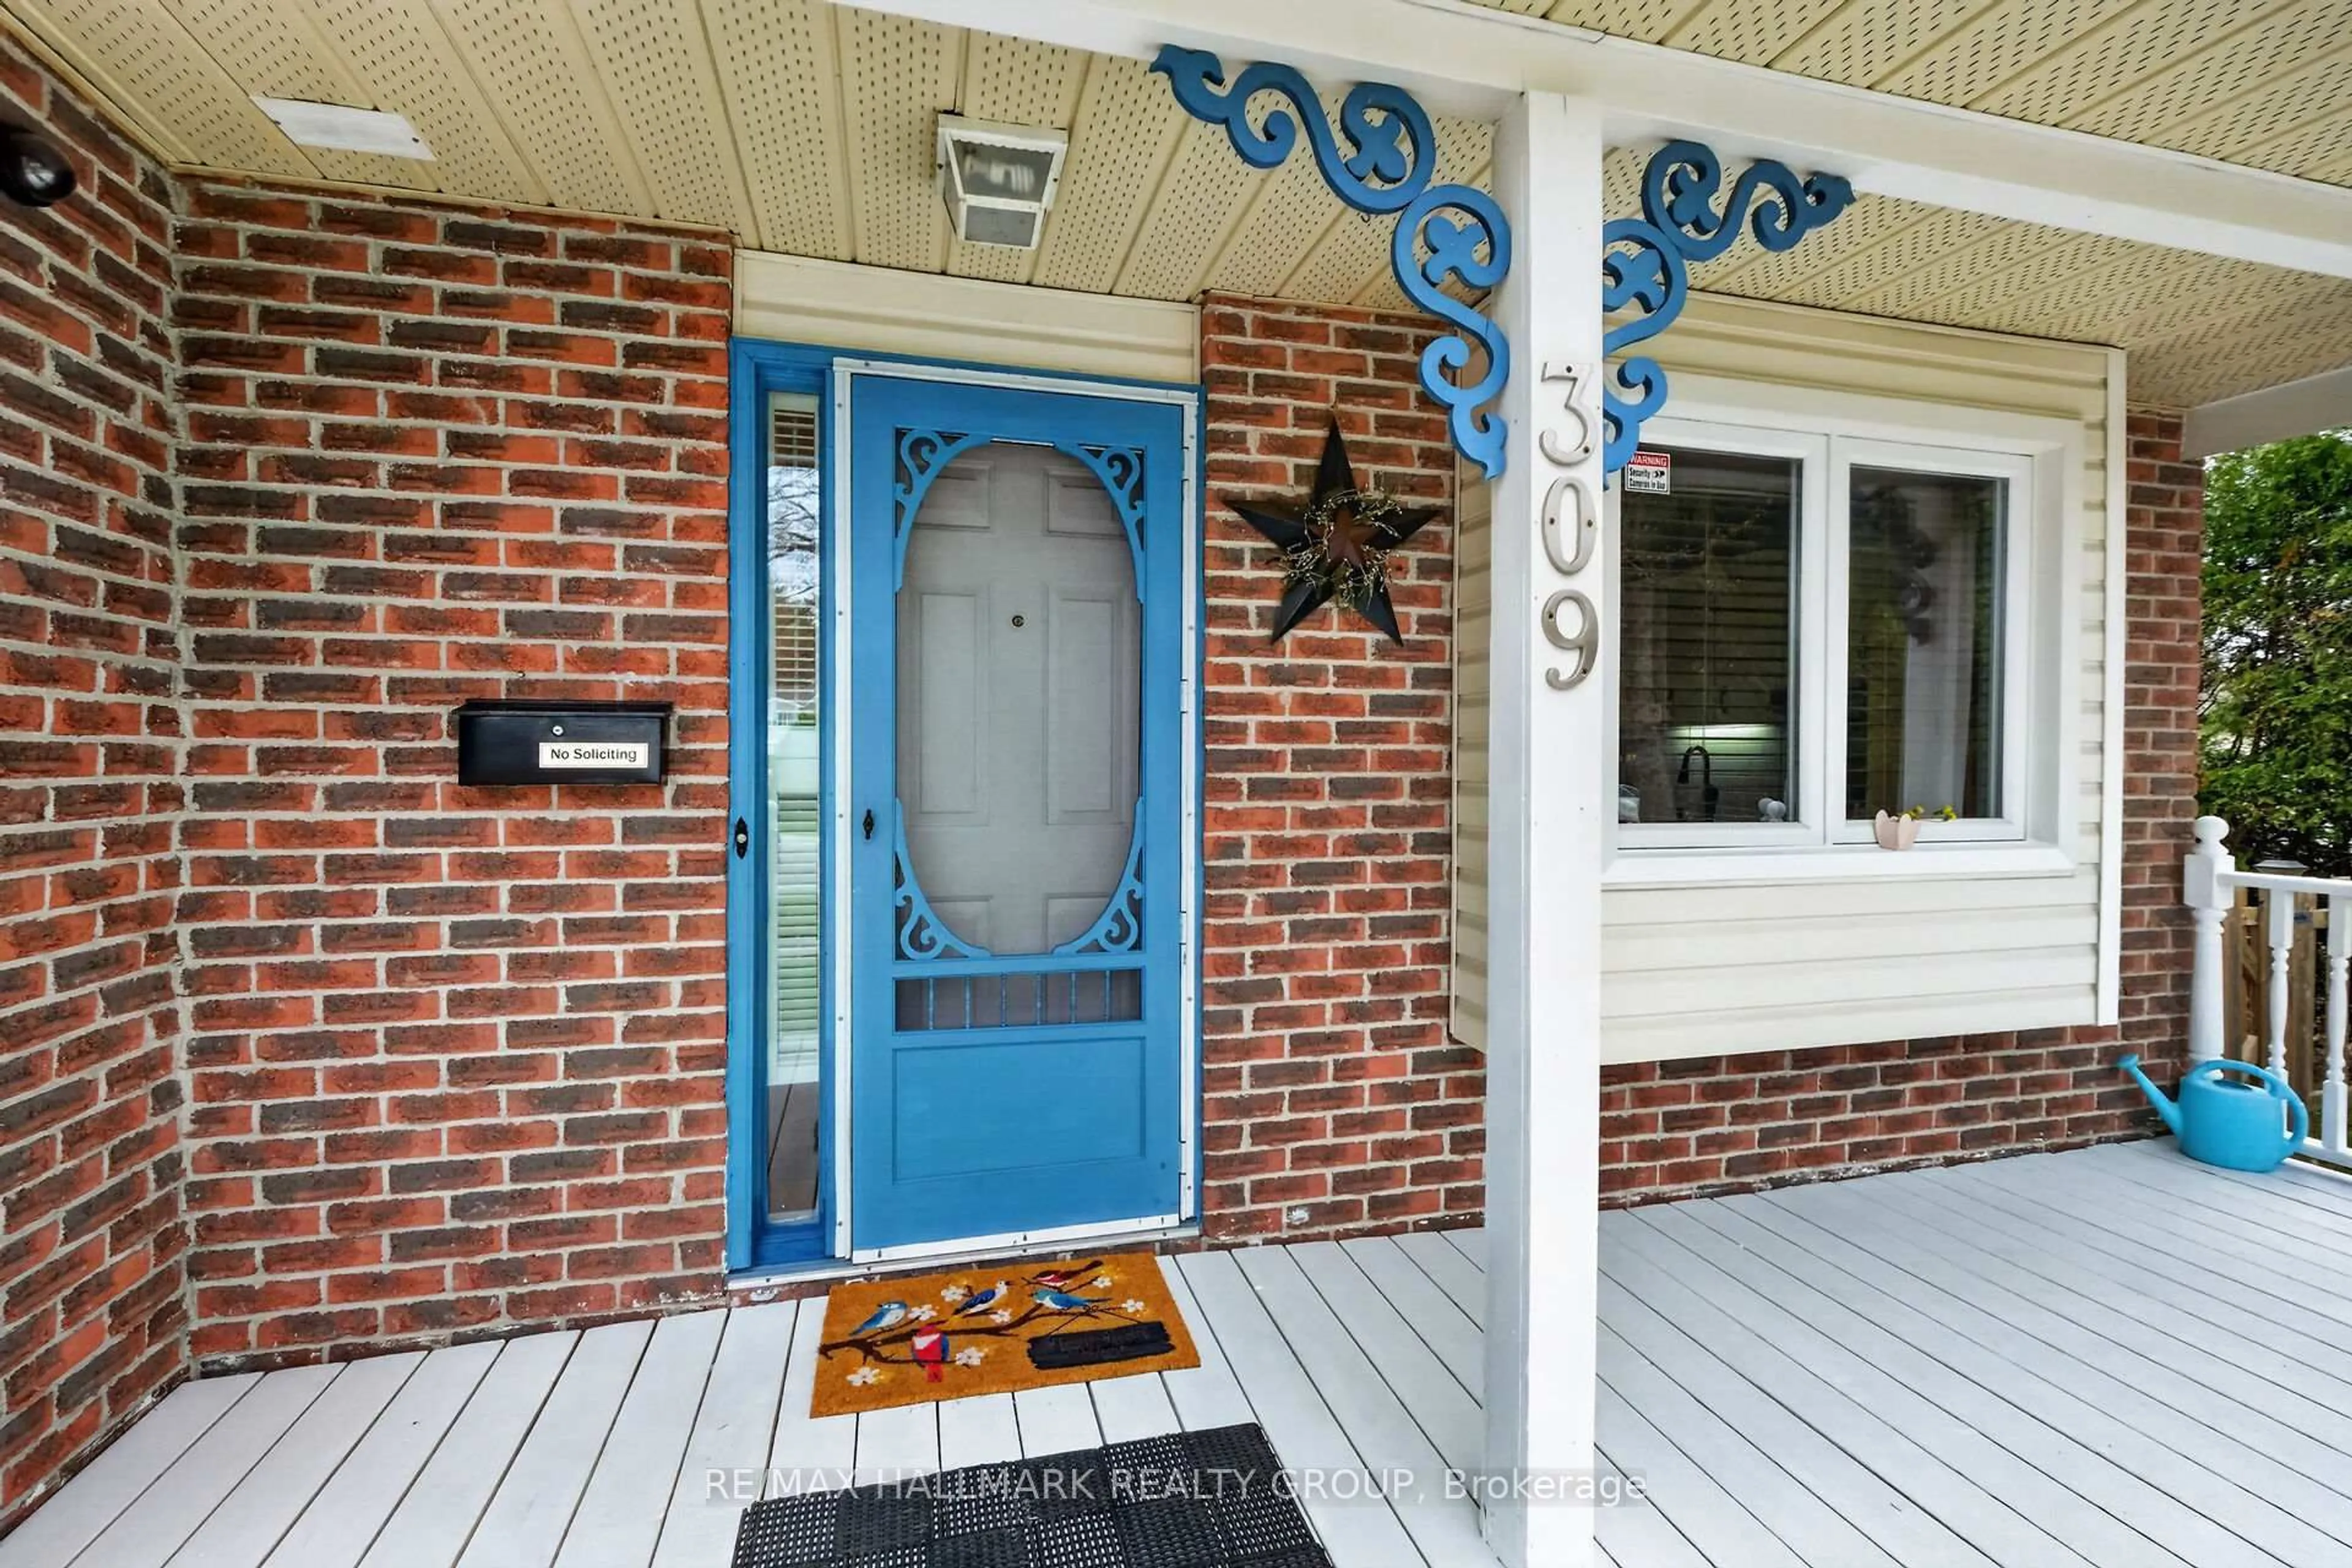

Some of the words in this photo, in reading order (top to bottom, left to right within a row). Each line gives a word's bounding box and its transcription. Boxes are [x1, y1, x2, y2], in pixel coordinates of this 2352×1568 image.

[1627, 454, 1667, 466] WARNING
[1629, 467, 1650, 479] Security
[1629, 478, 1649, 488] Cameras
[1539, 361, 1599, 691] 309
[551, 748, 570, 760] No
[573, 748, 638, 763] Soliciting
